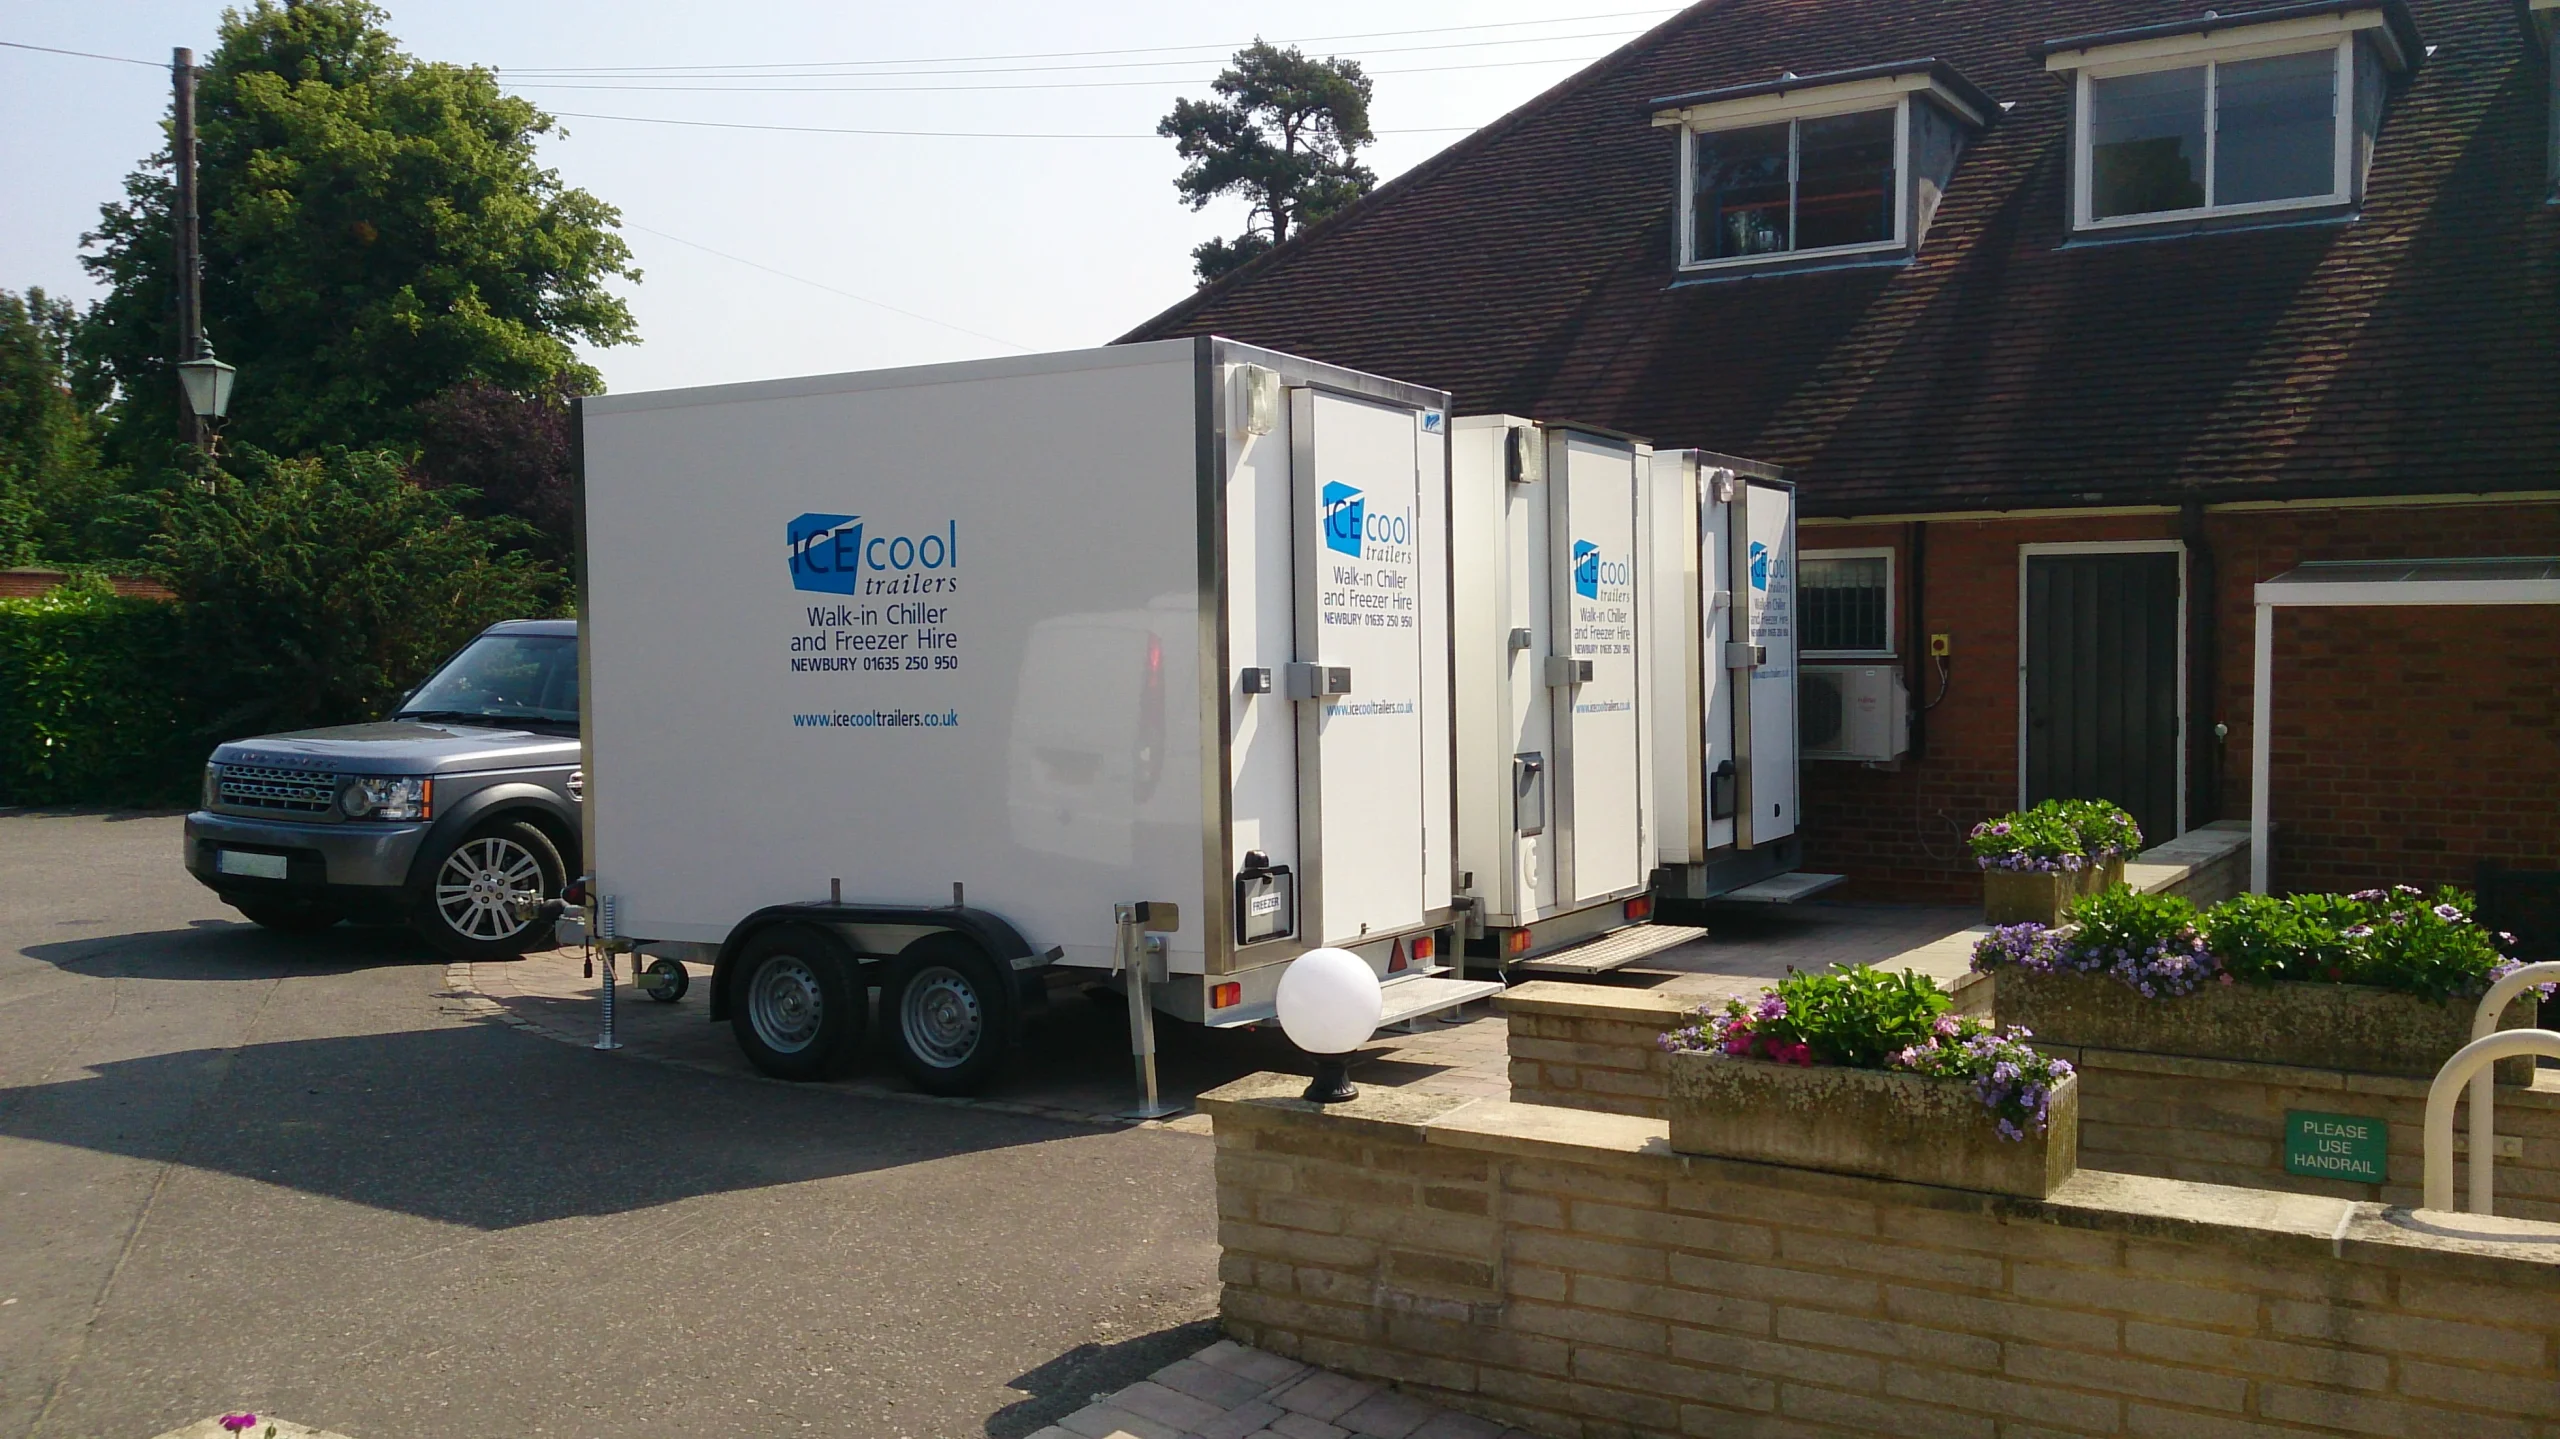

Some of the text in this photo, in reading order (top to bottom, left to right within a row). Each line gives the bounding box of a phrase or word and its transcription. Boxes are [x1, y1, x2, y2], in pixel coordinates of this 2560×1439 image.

[1366, 545, 1412, 565] trailers
[865, 573, 957, 595] trailers
[1333, 565, 1408, 590] Walk-in Chiller
[1324, 587, 1413, 611] and Freezer Hire
[1600, 588, 1631, 603] trailers
[807, 602, 948, 627] Walk-in Chiller
[1324, 611, 1413, 628] NEWBURY 01635 250 950
[790, 627, 958, 652] and Freezer Hire
[1574, 623, 1588, 640] and
[1590, 625, 1615, 640] Freezer
[791, 655, 958, 672] NEWBURY 01635 250 950
[1326, 698, 1413, 717] www.icecooltrailers.co.uk
[793, 708, 959, 727] www.icecooltrailers.co.uk
[1252, 896, 1280, 912] FREEZER
[2303, 1120, 2369, 1139] PLEASE
[2319, 1139, 2352, 1155] USE
[2294, 1153, 2376, 1174] HANDRAIL
